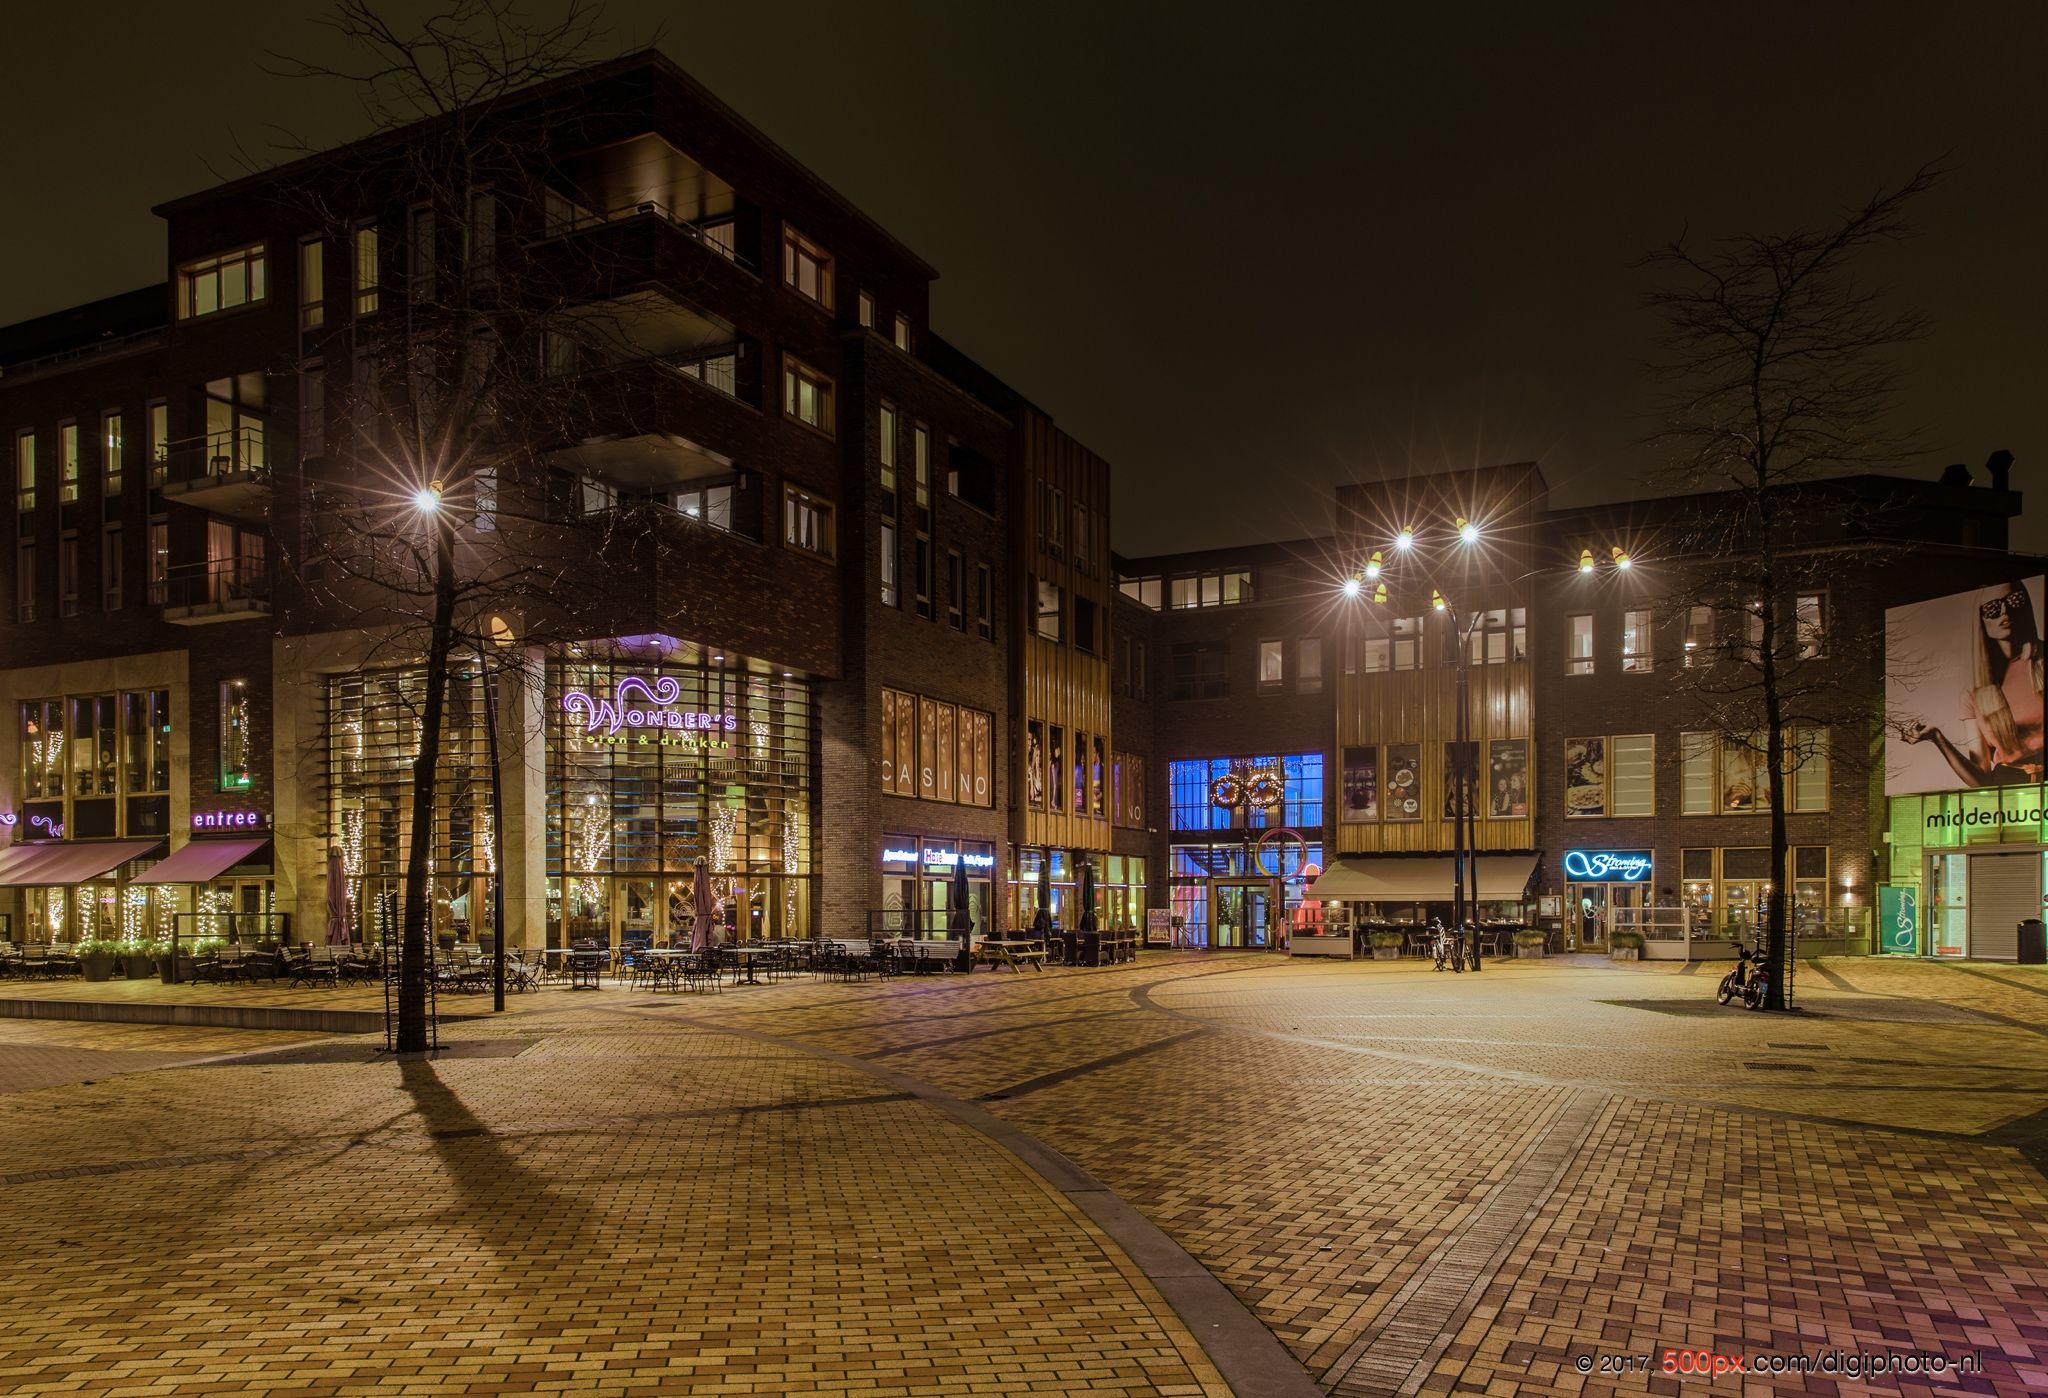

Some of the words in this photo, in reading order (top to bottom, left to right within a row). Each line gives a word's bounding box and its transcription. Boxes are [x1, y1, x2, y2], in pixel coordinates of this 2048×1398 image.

[638, 734, 649, 746] &
[882, 760, 987, 795] CASINO
[194, 811, 257, 826] entree
[1565, 851, 1652, 880] Stroming
